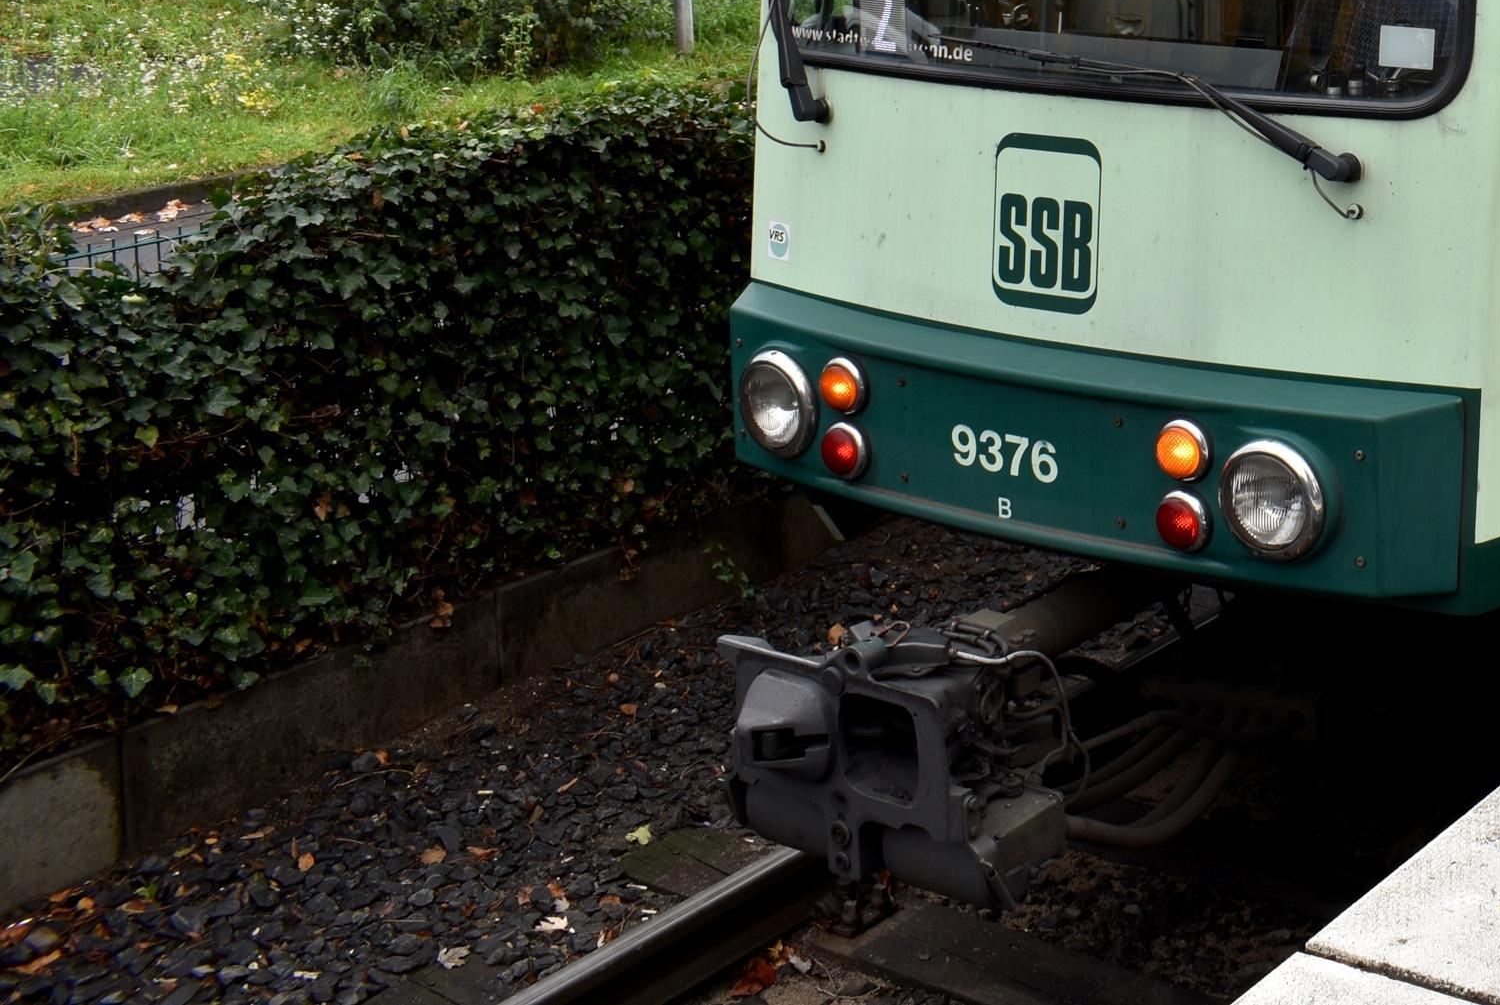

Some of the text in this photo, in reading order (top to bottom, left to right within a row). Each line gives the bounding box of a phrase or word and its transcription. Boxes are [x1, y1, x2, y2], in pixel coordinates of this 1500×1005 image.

[769, 228, 784, 242] VRS
[998, 193, 1093, 293] SSB
[951, 424, 1058, 483] 9376
[998, 497, 1012, 519] B
